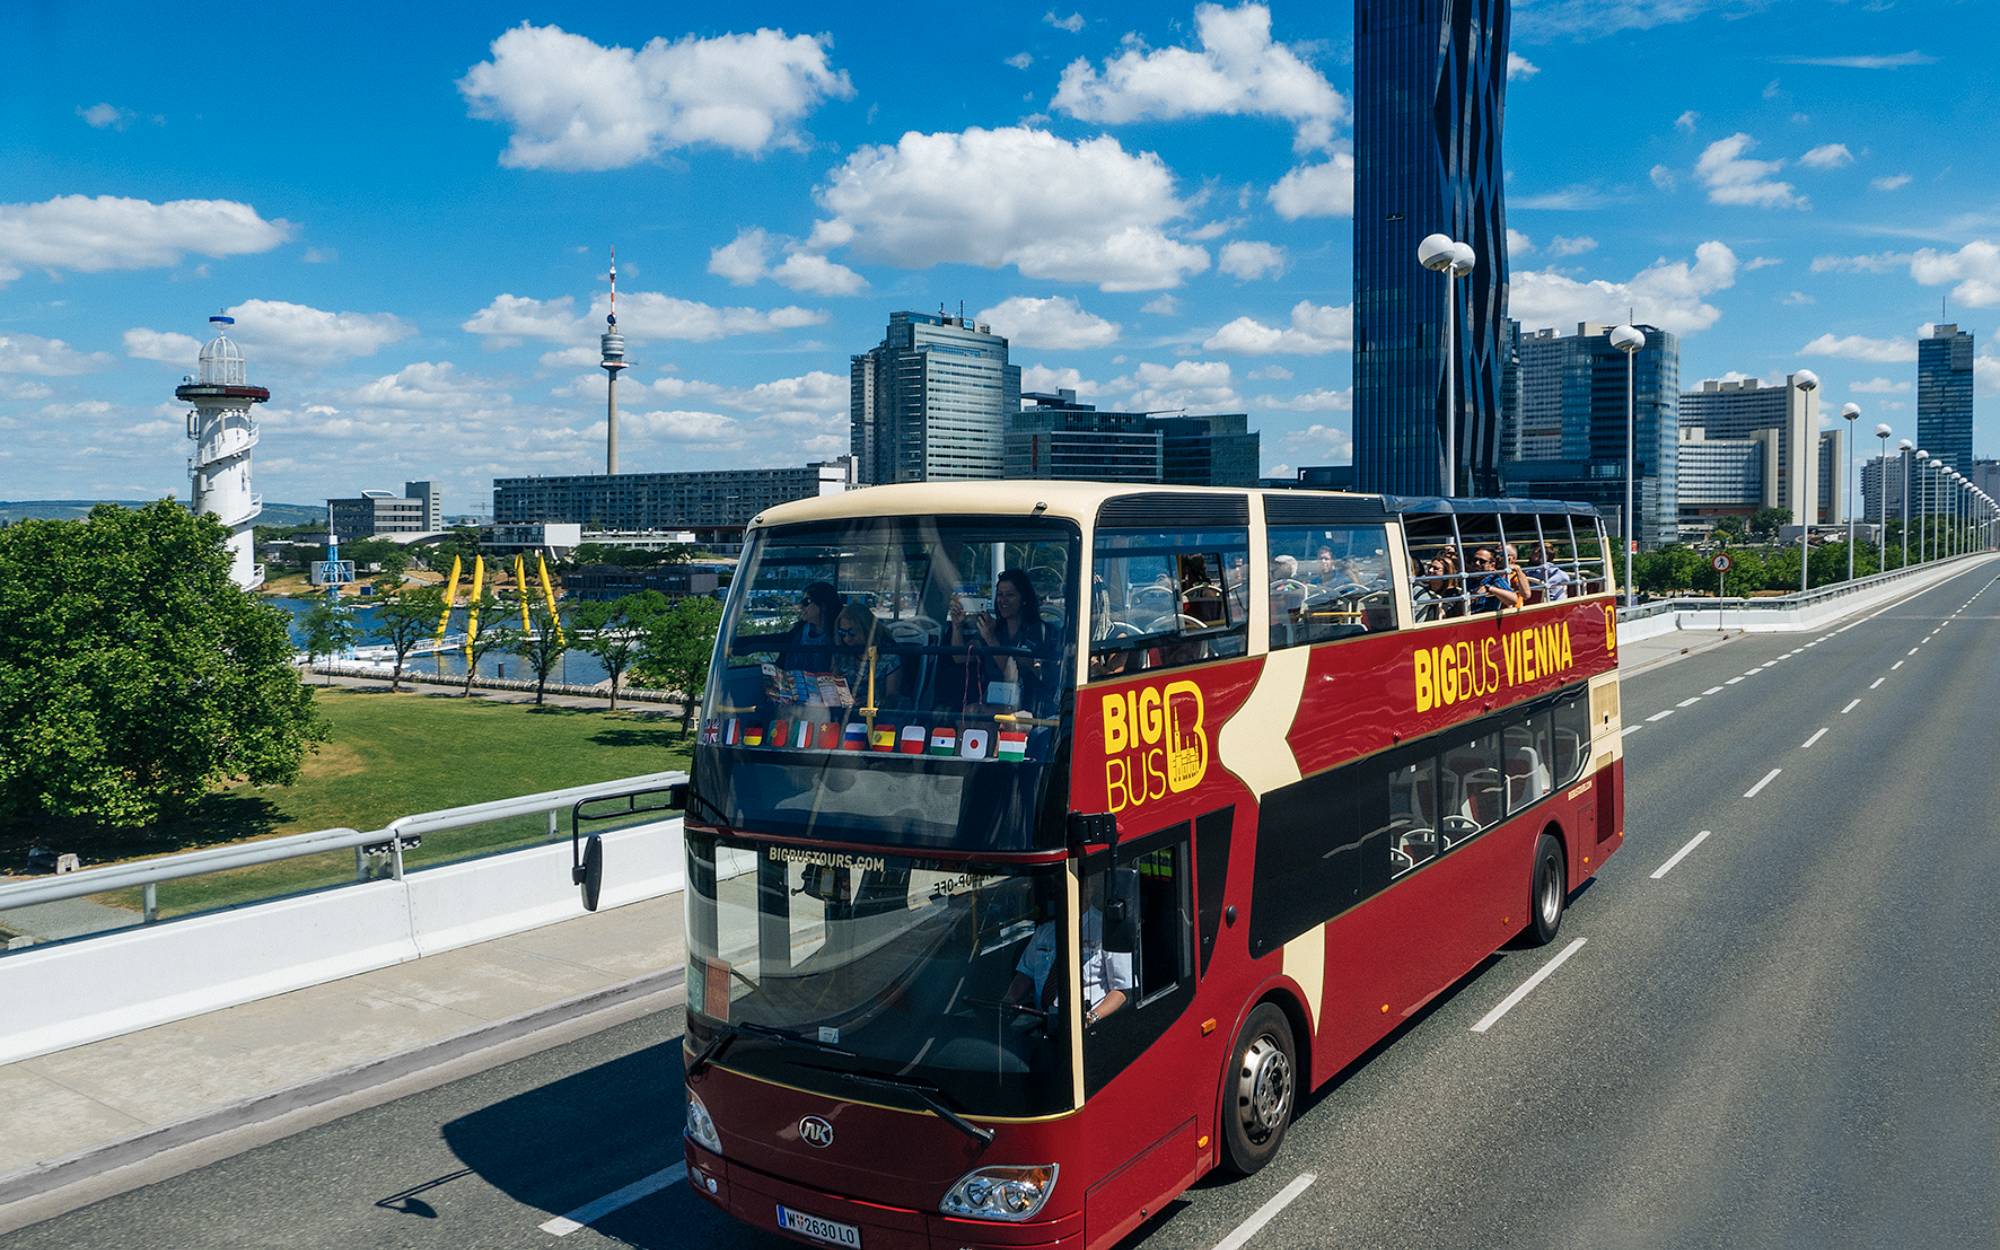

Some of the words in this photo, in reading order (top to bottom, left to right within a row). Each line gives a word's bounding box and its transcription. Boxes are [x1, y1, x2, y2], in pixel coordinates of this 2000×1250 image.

[1502, 621, 1573, 687] VIENNA
[1102, 686, 1163, 755] BIG
[1106, 747, 1167, 813] BUS
[769, 847, 884, 872] BIGBUSTOURS.COM
[804, 1217, 836, 1240] 2630
